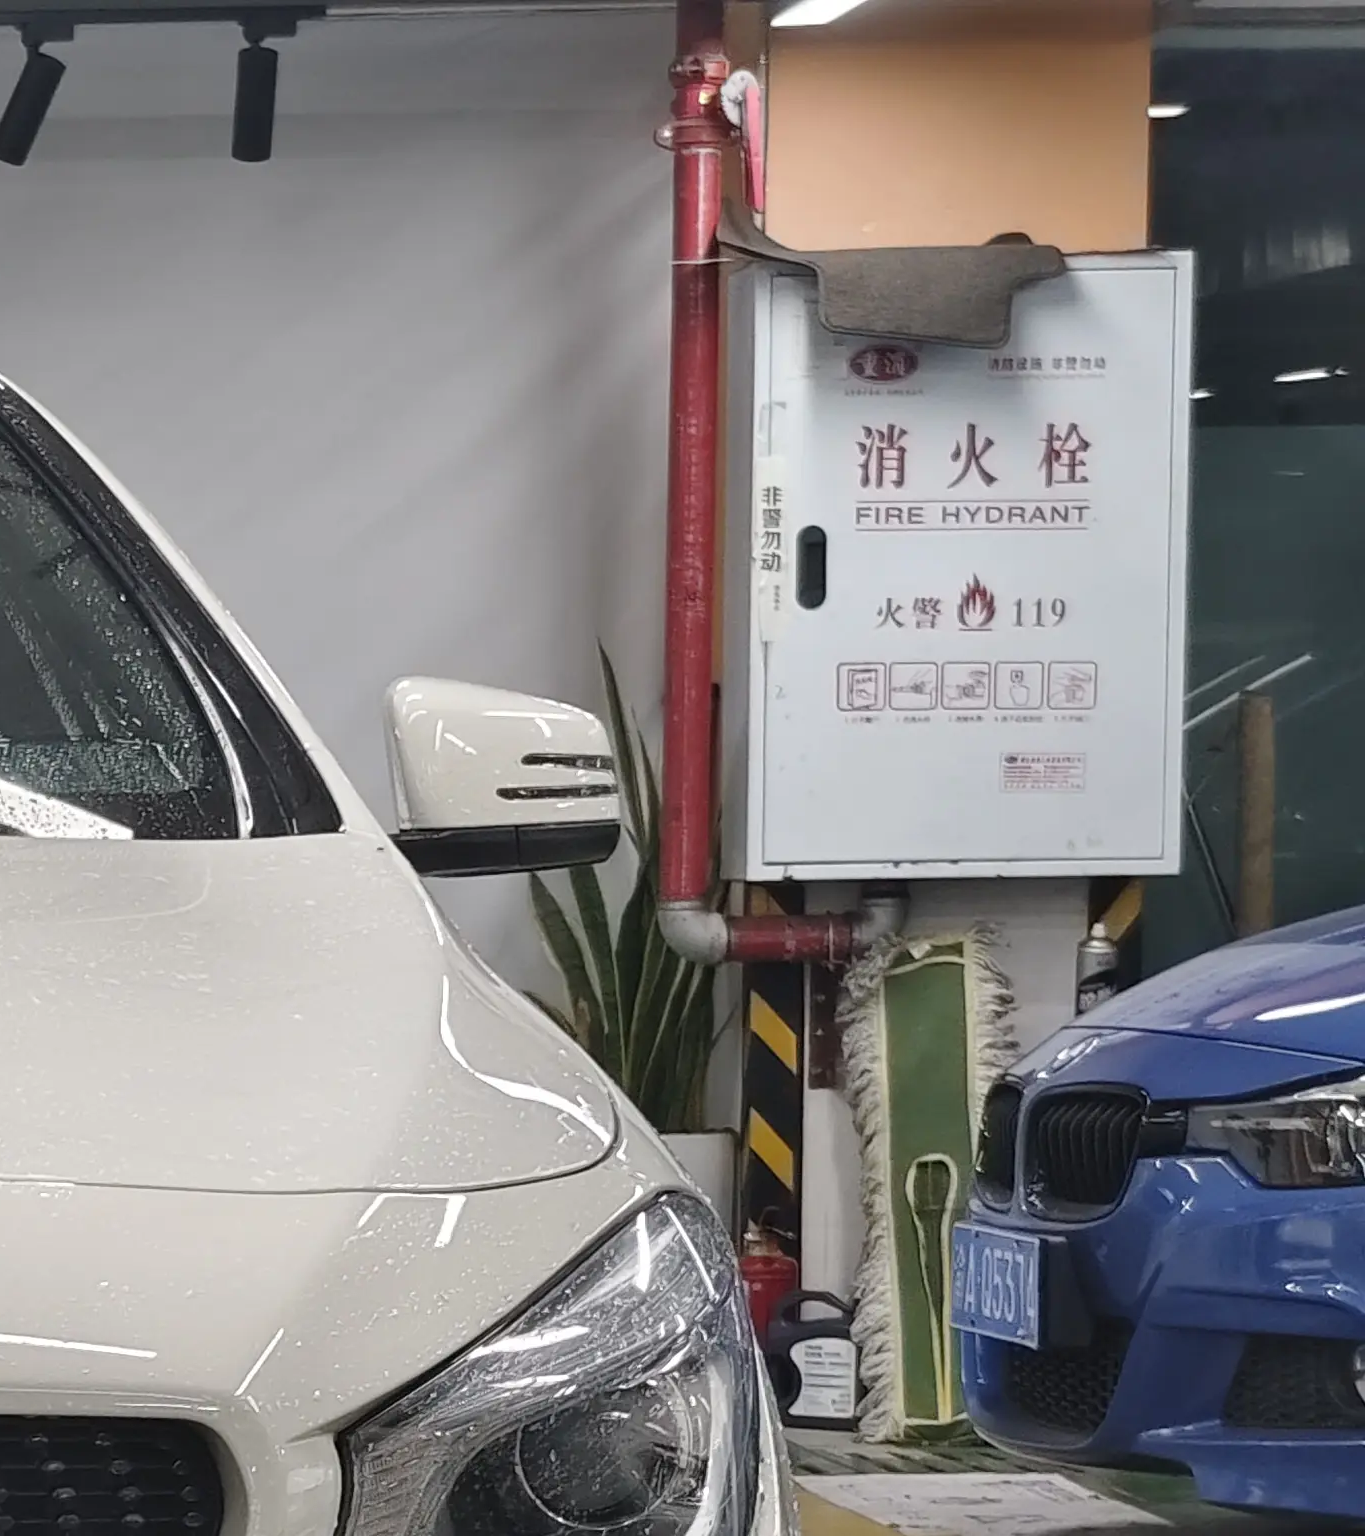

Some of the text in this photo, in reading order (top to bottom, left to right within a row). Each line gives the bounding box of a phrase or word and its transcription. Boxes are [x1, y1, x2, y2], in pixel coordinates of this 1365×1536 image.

[855, 422, 1092, 489] 消火栓
[760, 486, 783, 573] 非警勿动
[855, 505, 1090, 525] FIRE HYDRANT
[875, 597, 1067, 629] 火警 119
